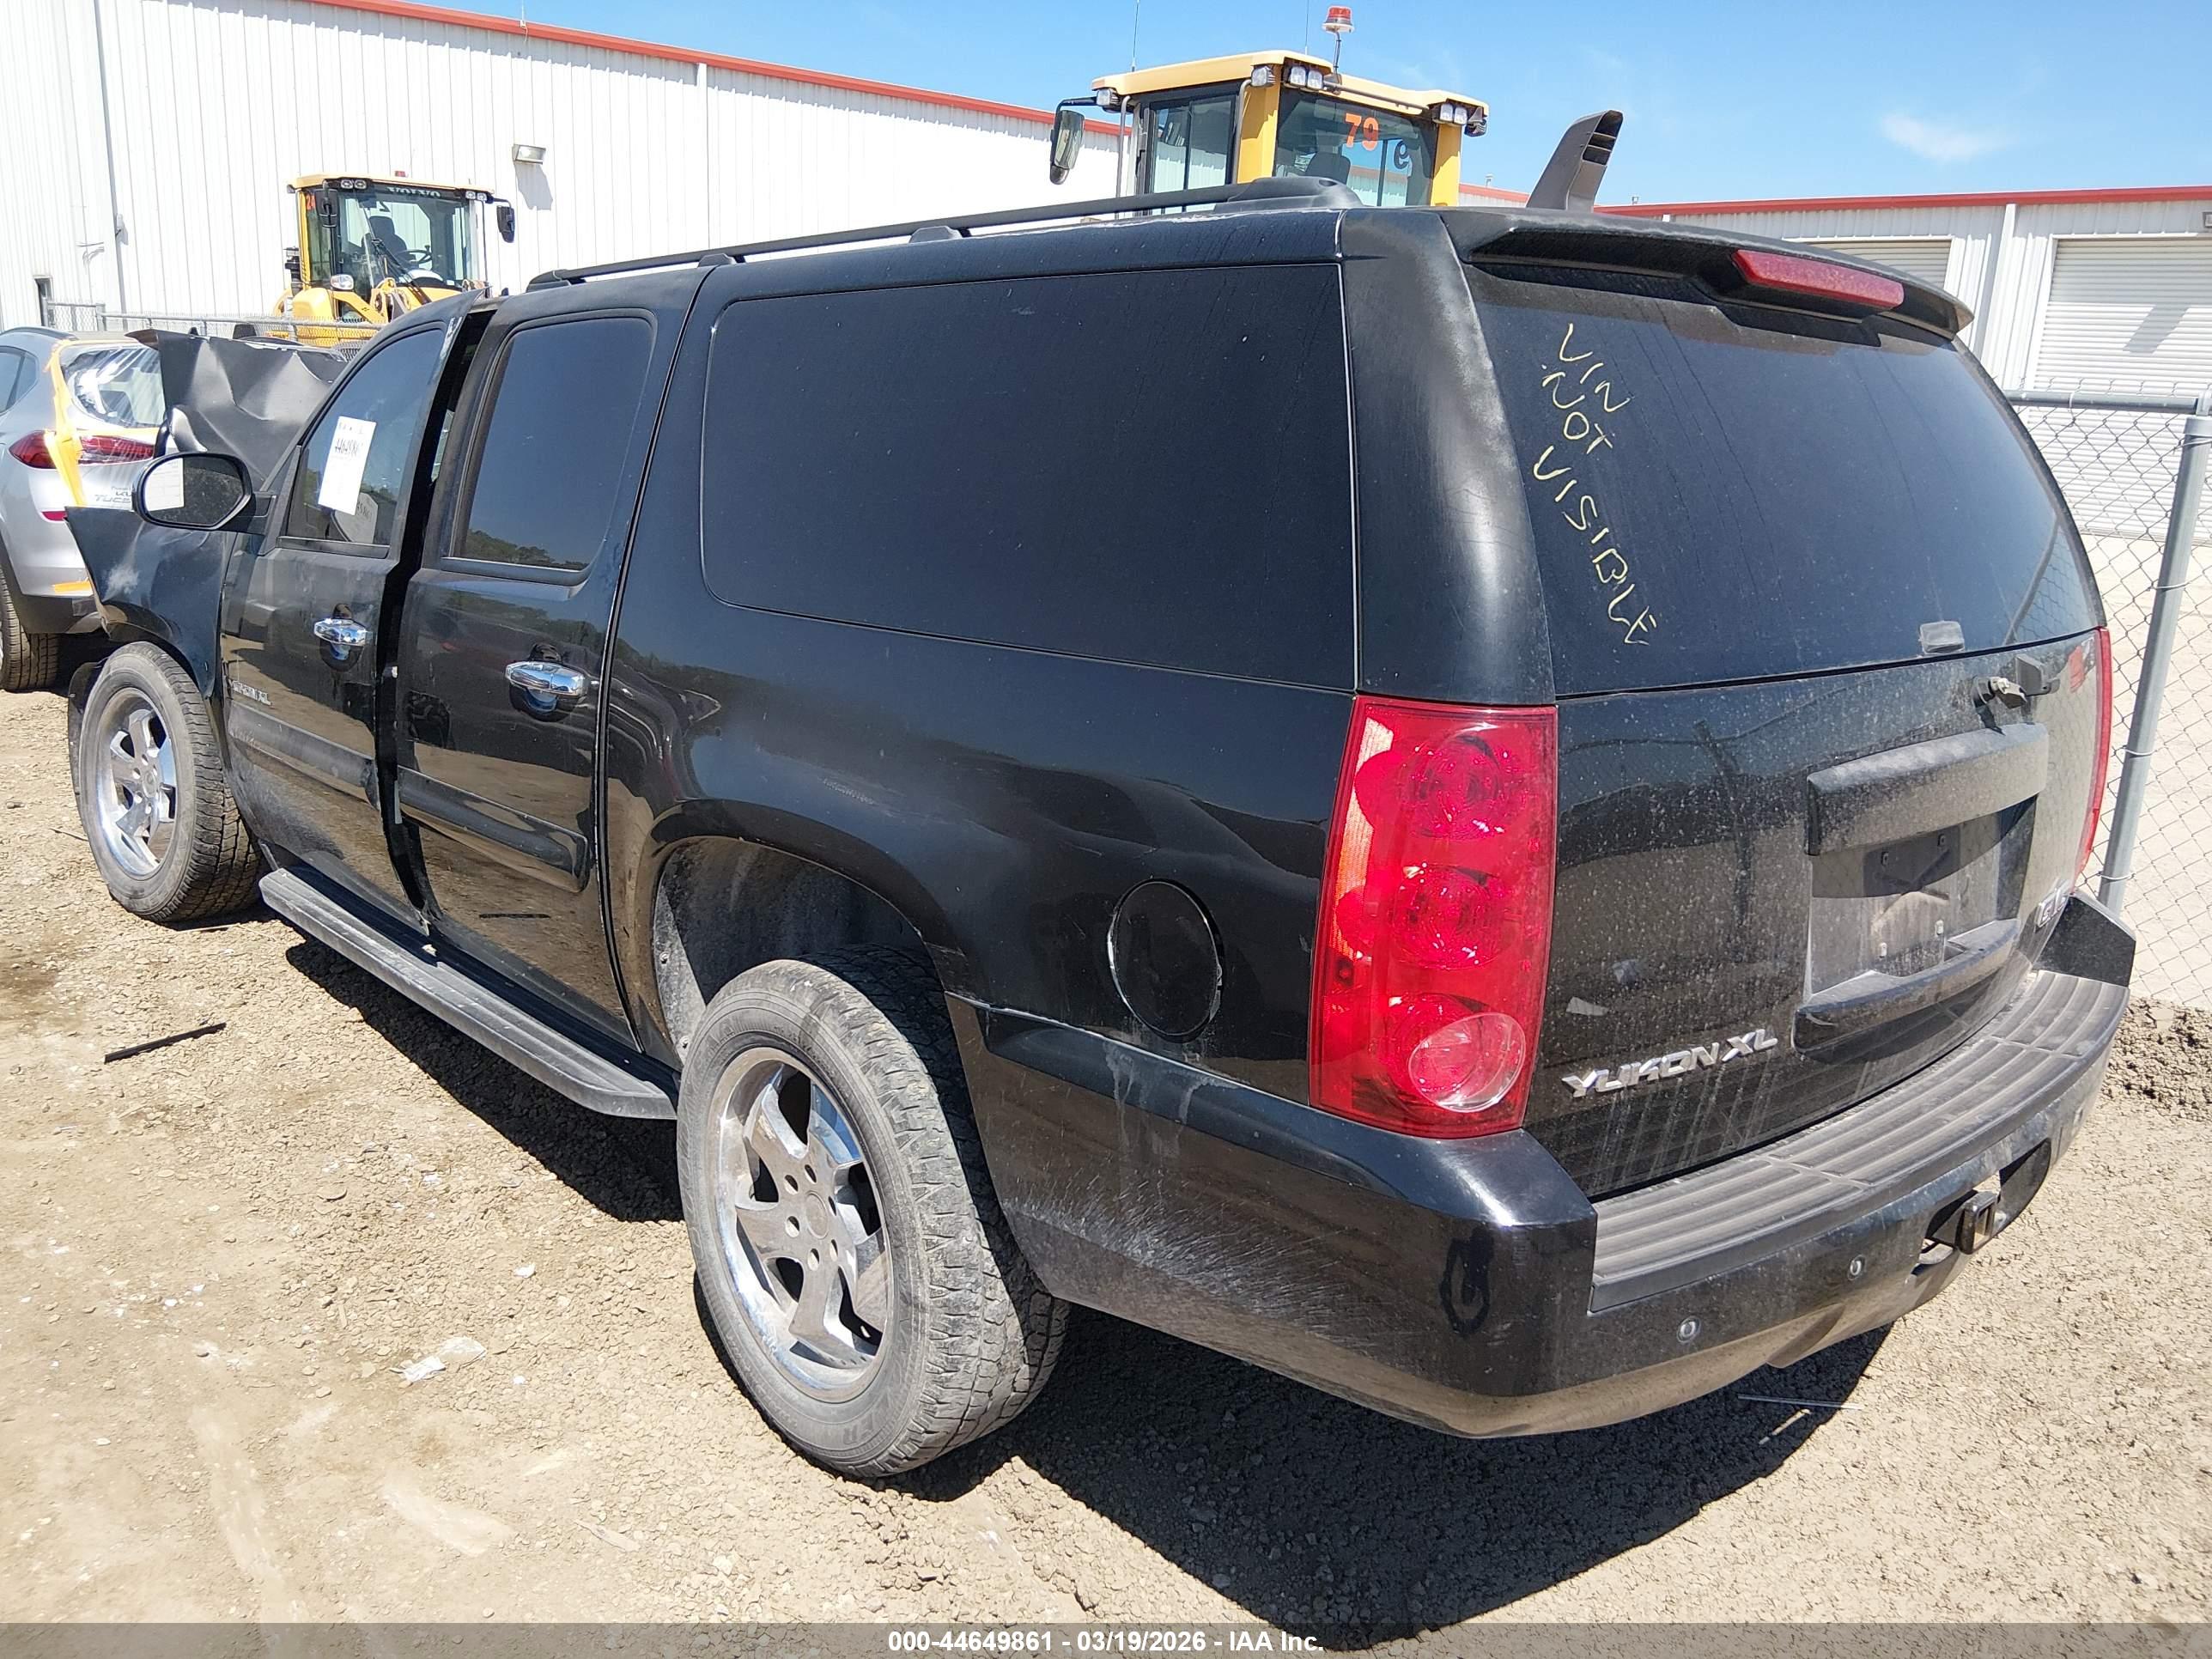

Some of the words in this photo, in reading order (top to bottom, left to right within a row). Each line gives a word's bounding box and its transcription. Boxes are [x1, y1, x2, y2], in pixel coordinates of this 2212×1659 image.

[1345, 112, 1379, 151] 79
[1559, 323, 1632, 413] VIN
[1541, 371, 1614, 454] NOT
[1532, 445, 1657, 646] VISIBLE
[1561, 1042, 1720, 1098] YUKON
[1721, 1029, 1779, 1063] XL
